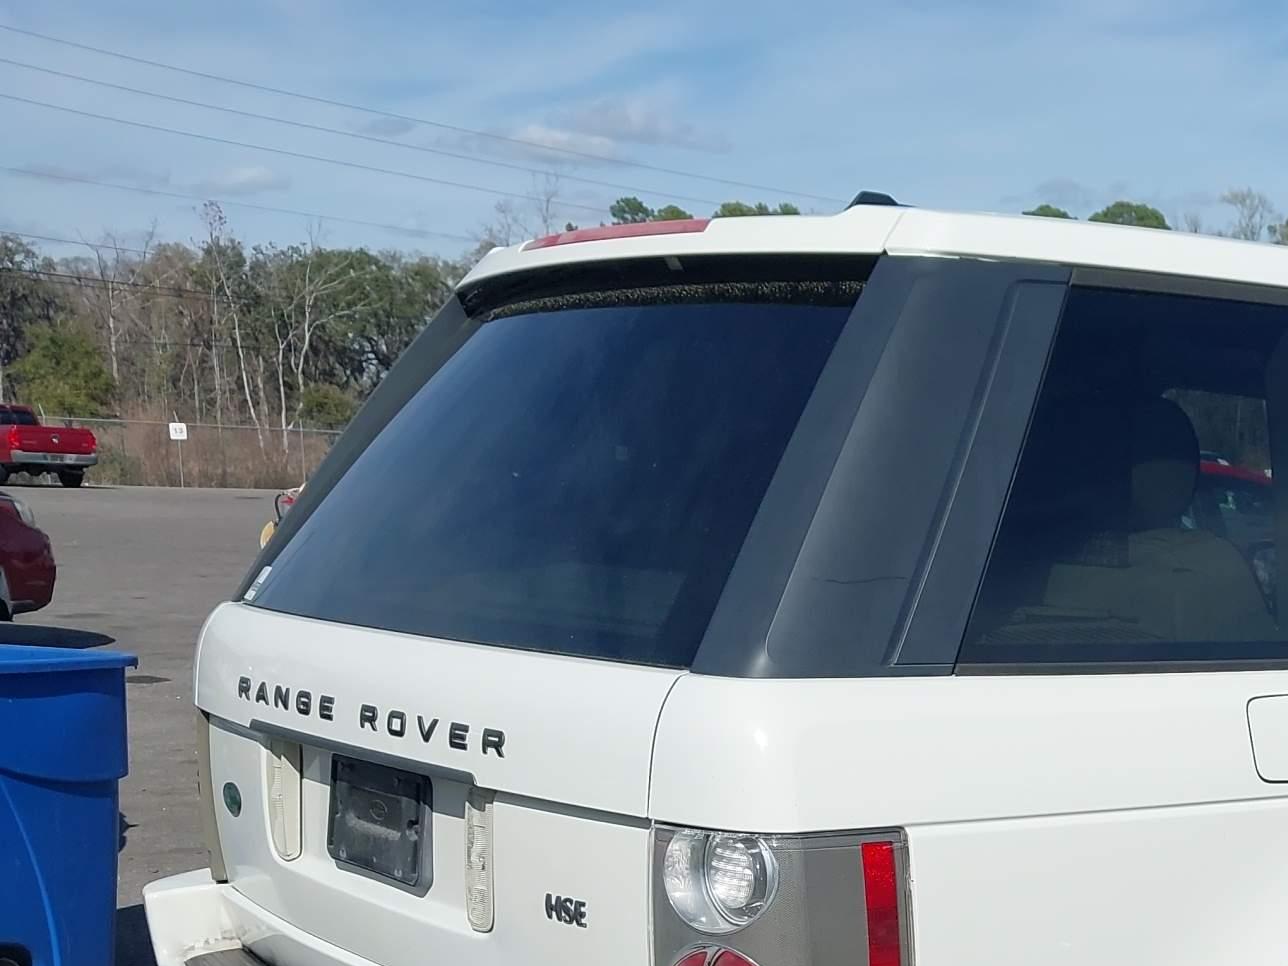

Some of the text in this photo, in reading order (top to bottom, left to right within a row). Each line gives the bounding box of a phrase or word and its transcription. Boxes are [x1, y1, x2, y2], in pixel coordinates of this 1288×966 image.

[237, 675, 507, 759] RANGE ROVER
[544, 892, 589, 929] HSE
